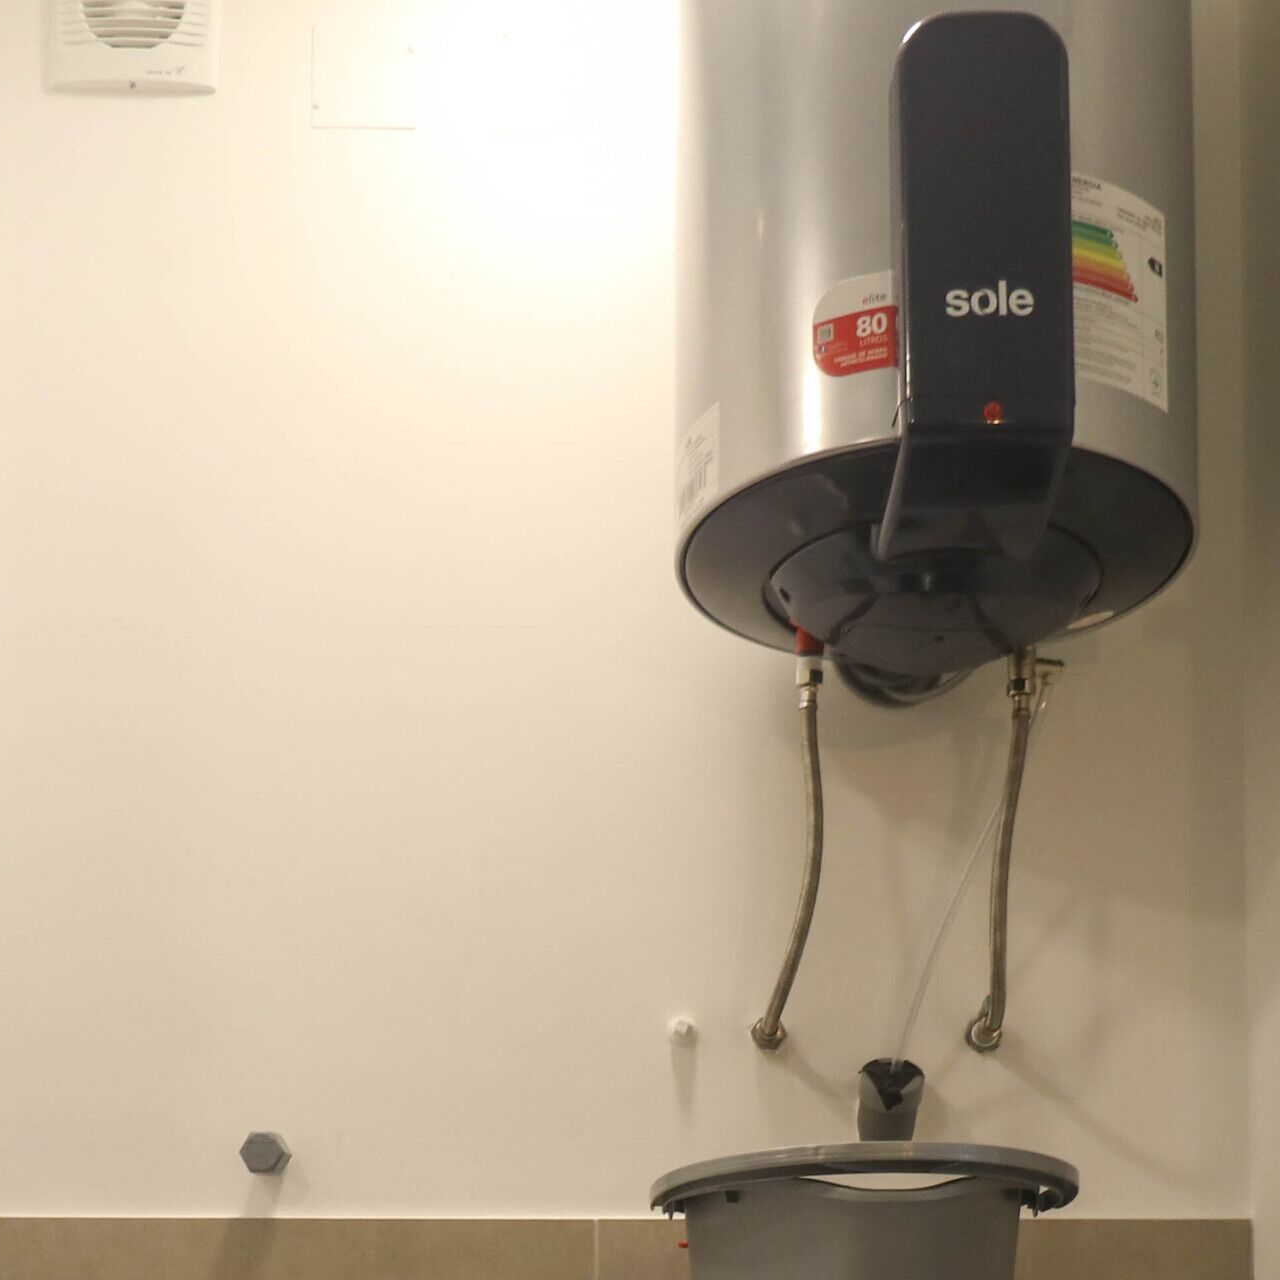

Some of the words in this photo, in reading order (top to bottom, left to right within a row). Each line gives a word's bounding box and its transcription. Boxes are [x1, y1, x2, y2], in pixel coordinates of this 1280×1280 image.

[862, 293, 888, 305] elite
[945, 279, 1034, 317] sole
[856, 312, 888, 337] 80
